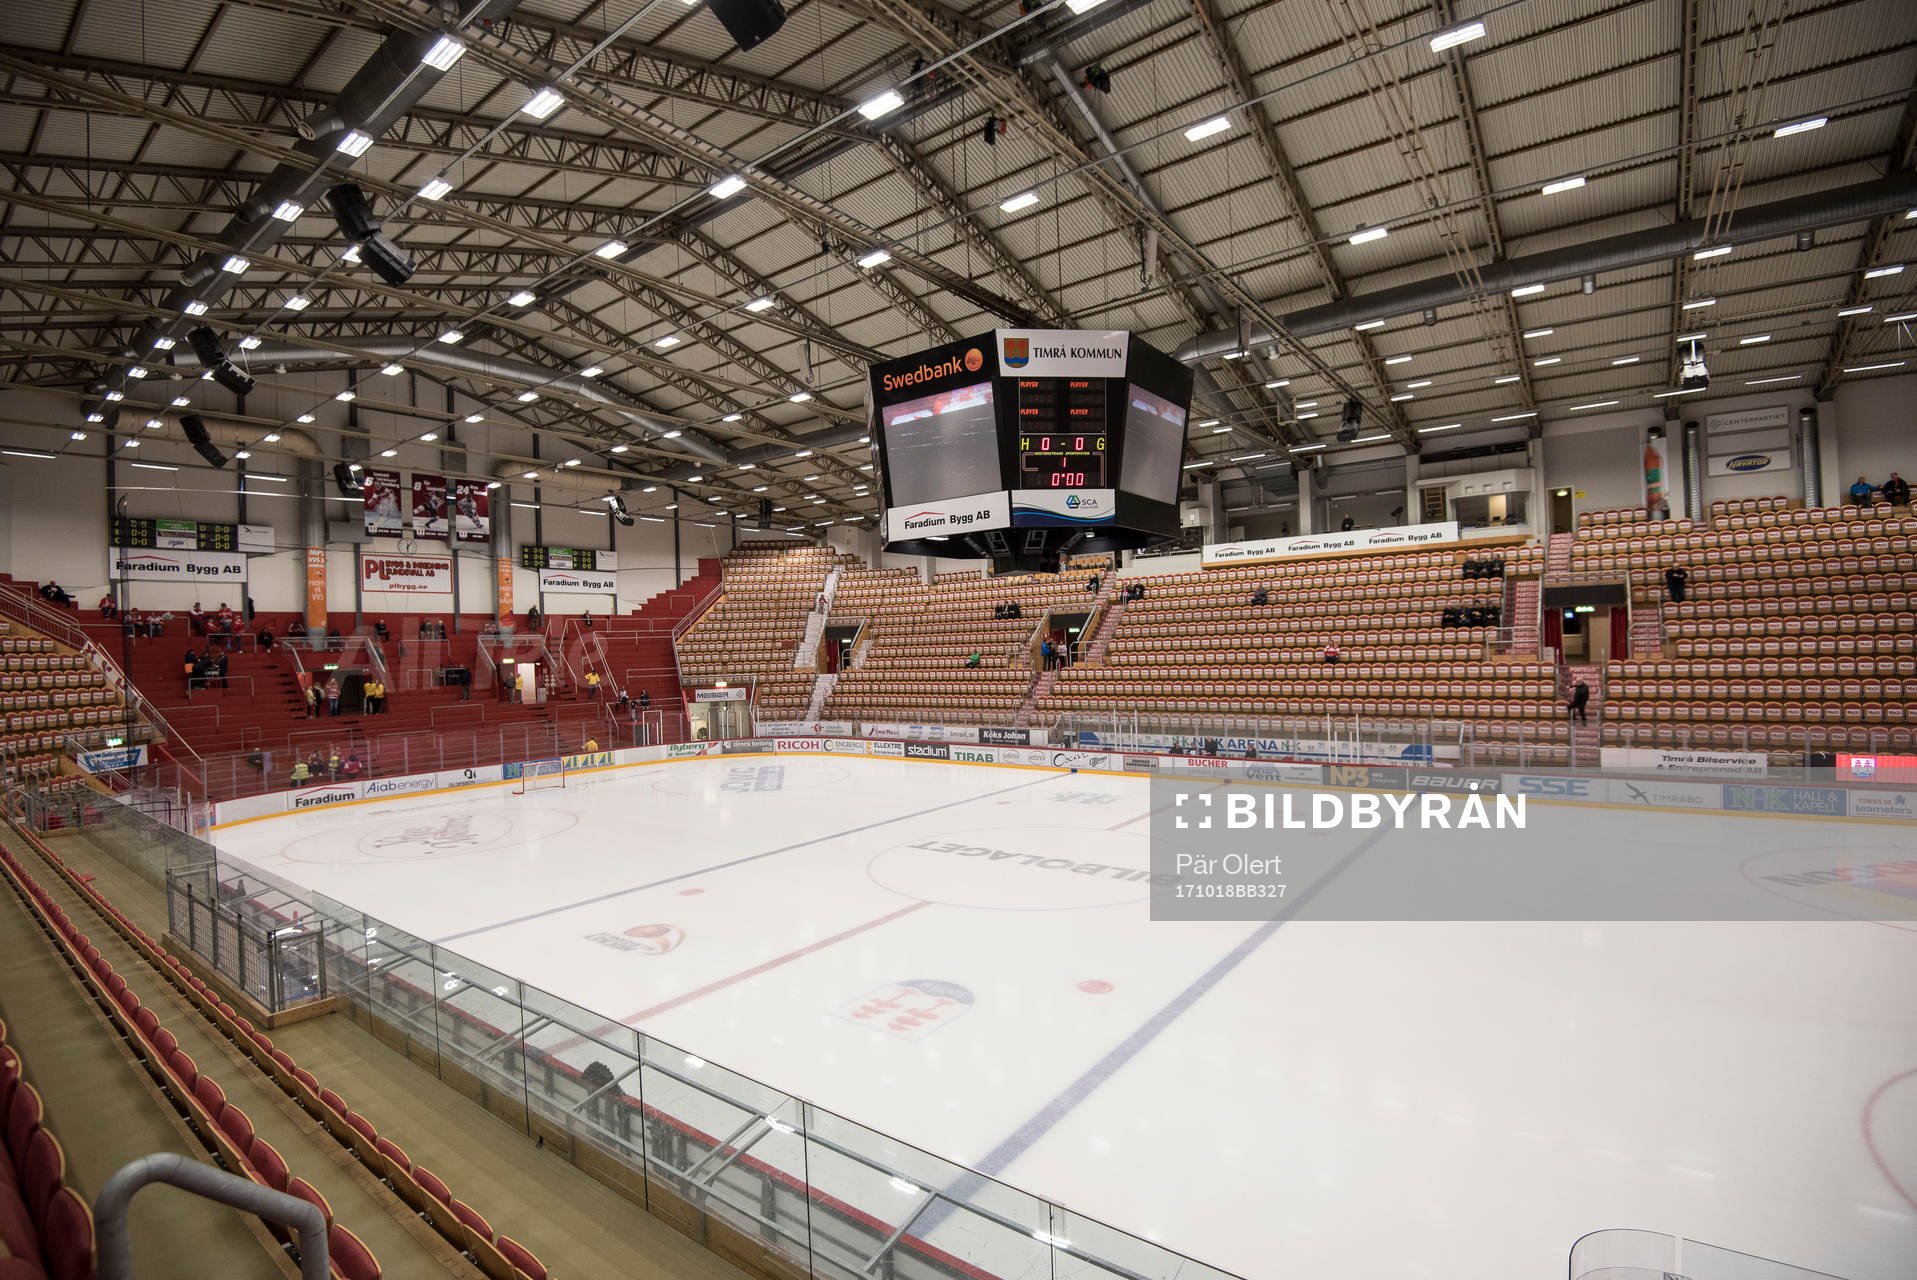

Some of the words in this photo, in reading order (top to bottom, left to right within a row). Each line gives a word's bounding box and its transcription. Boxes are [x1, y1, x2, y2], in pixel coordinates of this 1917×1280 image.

[1033, 343, 1067, 359] TIMRÅ
[1070, 347, 1122, 359] KOMMUN
[883, 356, 963, 391] Swedbank
[1021, 437, 1030, 451] H
[1041, 437, 1050, 451] 0
[1075, 437, 1084, 451] 0
[1096, 437, 1105, 451] G
[414, 481, 421, 491] 8
[457, 485, 469, 494] 24
[904, 516, 945, 530] Faradium
[949, 513, 973, 527] Bygg
[976, 510, 990, 520] AB
[1369, 536, 1405, 544] Faradium
[1408, 534, 1428, 542] Bygg
[1288, 543, 1321, 551] Faradium
[1323, 542, 1342, 550] Bygg
[1215, 550, 1245, 558] Faradium
[116, 561, 179, 572] Faradium
[187, 564, 218, 575] Bygg
[223, 565, 241, 574] AB
[364, 559, 390, 580] PL
[543, 579, 579, 587] Faradium
[582, 580, 601, 588] Bygg
[696, 691, 729, 699] MEISER
[777, 741, 820, 750] RICOH
[1227, 738, 1278, 751] ARENA
[908, 745, 947, 757] stadium
[954, 752, 993, 762] TIRAB
[1696, 756, 1756, 765] Bilservice
[1188, 758, 1228, 768] BUCHER
[1668, 764, 1744, 774] Entreprenad
[1246, 773, 1282, 782] vent
[1331, 765, 1370, 787] NP3
[1411, 775, 1499, 790] BAUER
[1518, 776, 1591, 796] SSE
[295, 791, 355, 808] Faradium
[1652, 792, 1703, 803] TIMRÅBO
[1793, 790, 1822, 801] HALL
[1827, 793, 1838, 802] &
[1793, 801, 1838, 813] KAPELL
[1855, 804, 1912, 815] teamsters
[906, 840, 1185, 887] BILBOLAGET
